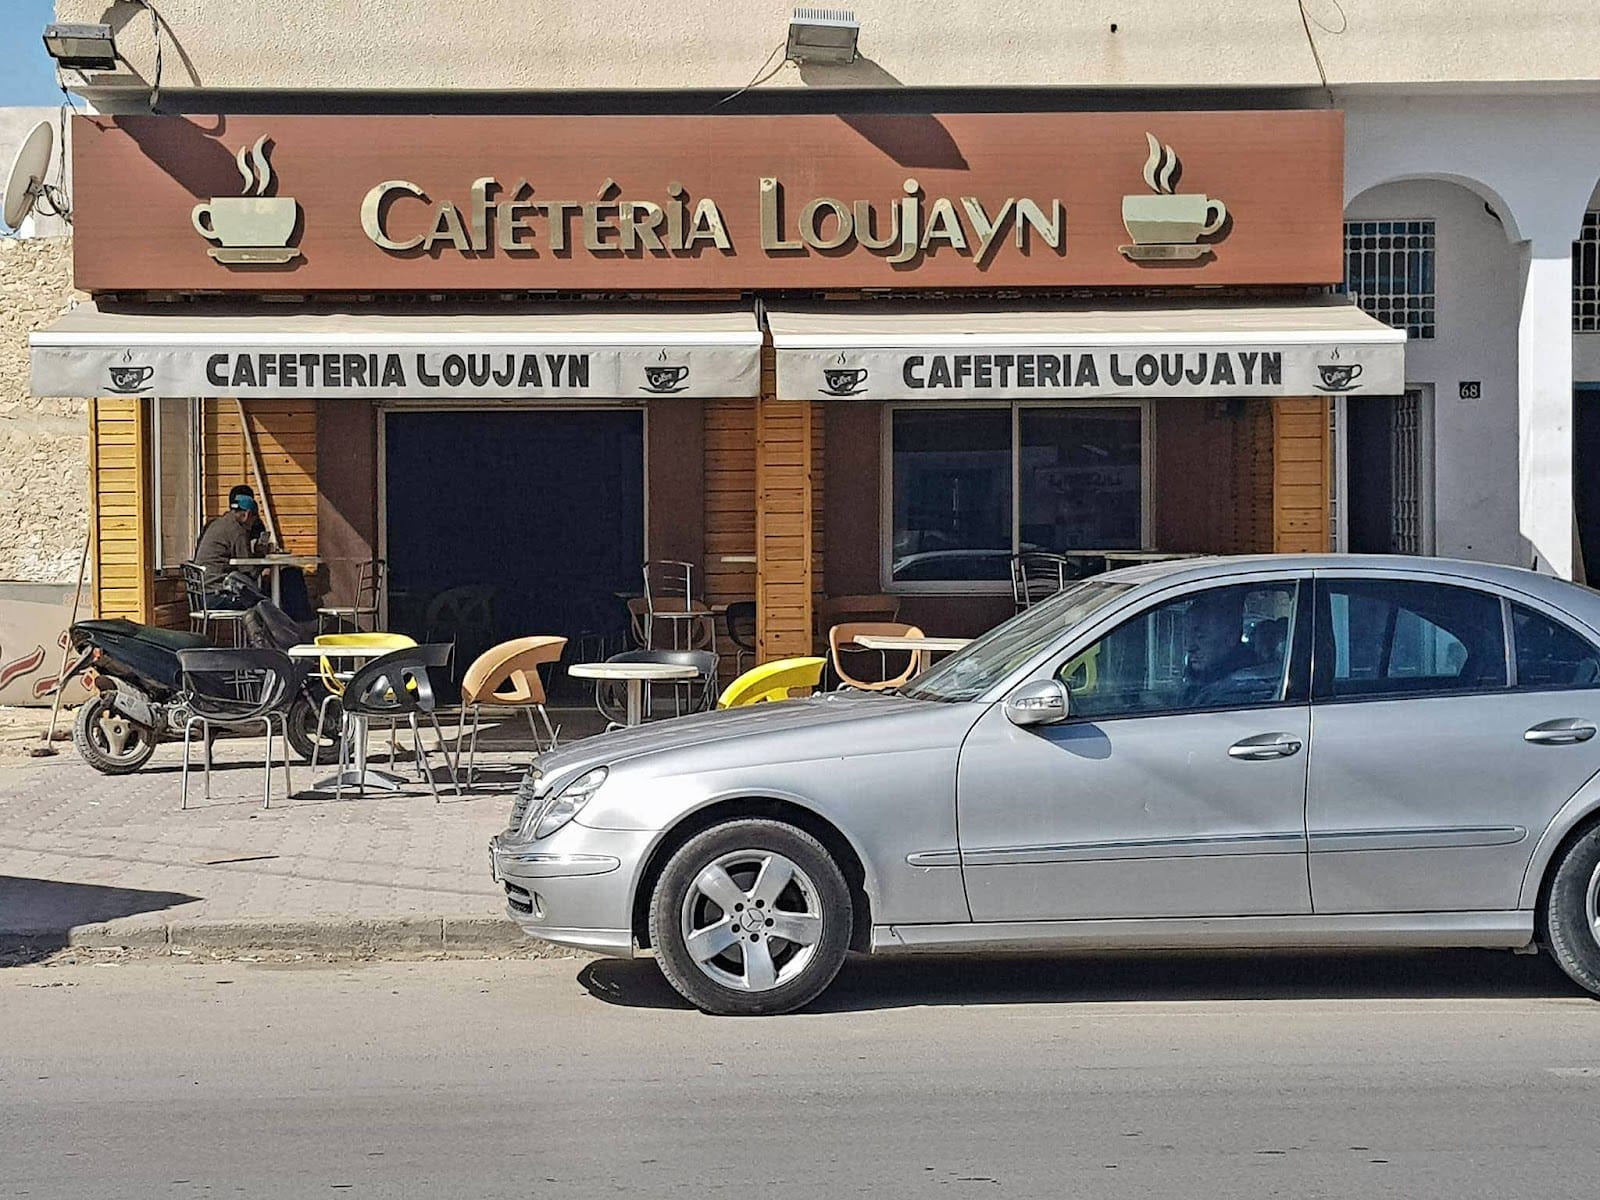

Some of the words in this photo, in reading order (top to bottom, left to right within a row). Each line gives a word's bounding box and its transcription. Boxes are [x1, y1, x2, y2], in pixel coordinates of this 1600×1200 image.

[206, 353, 407, 387] CAFETERIA
[416, 354, 590, 387] LOUJAYN
[902, 354, 1100, 389] CAFETERIA
[1109, 351, 1283, 387] LOUJAYN
[1461, 384, 1479, 398] 68
